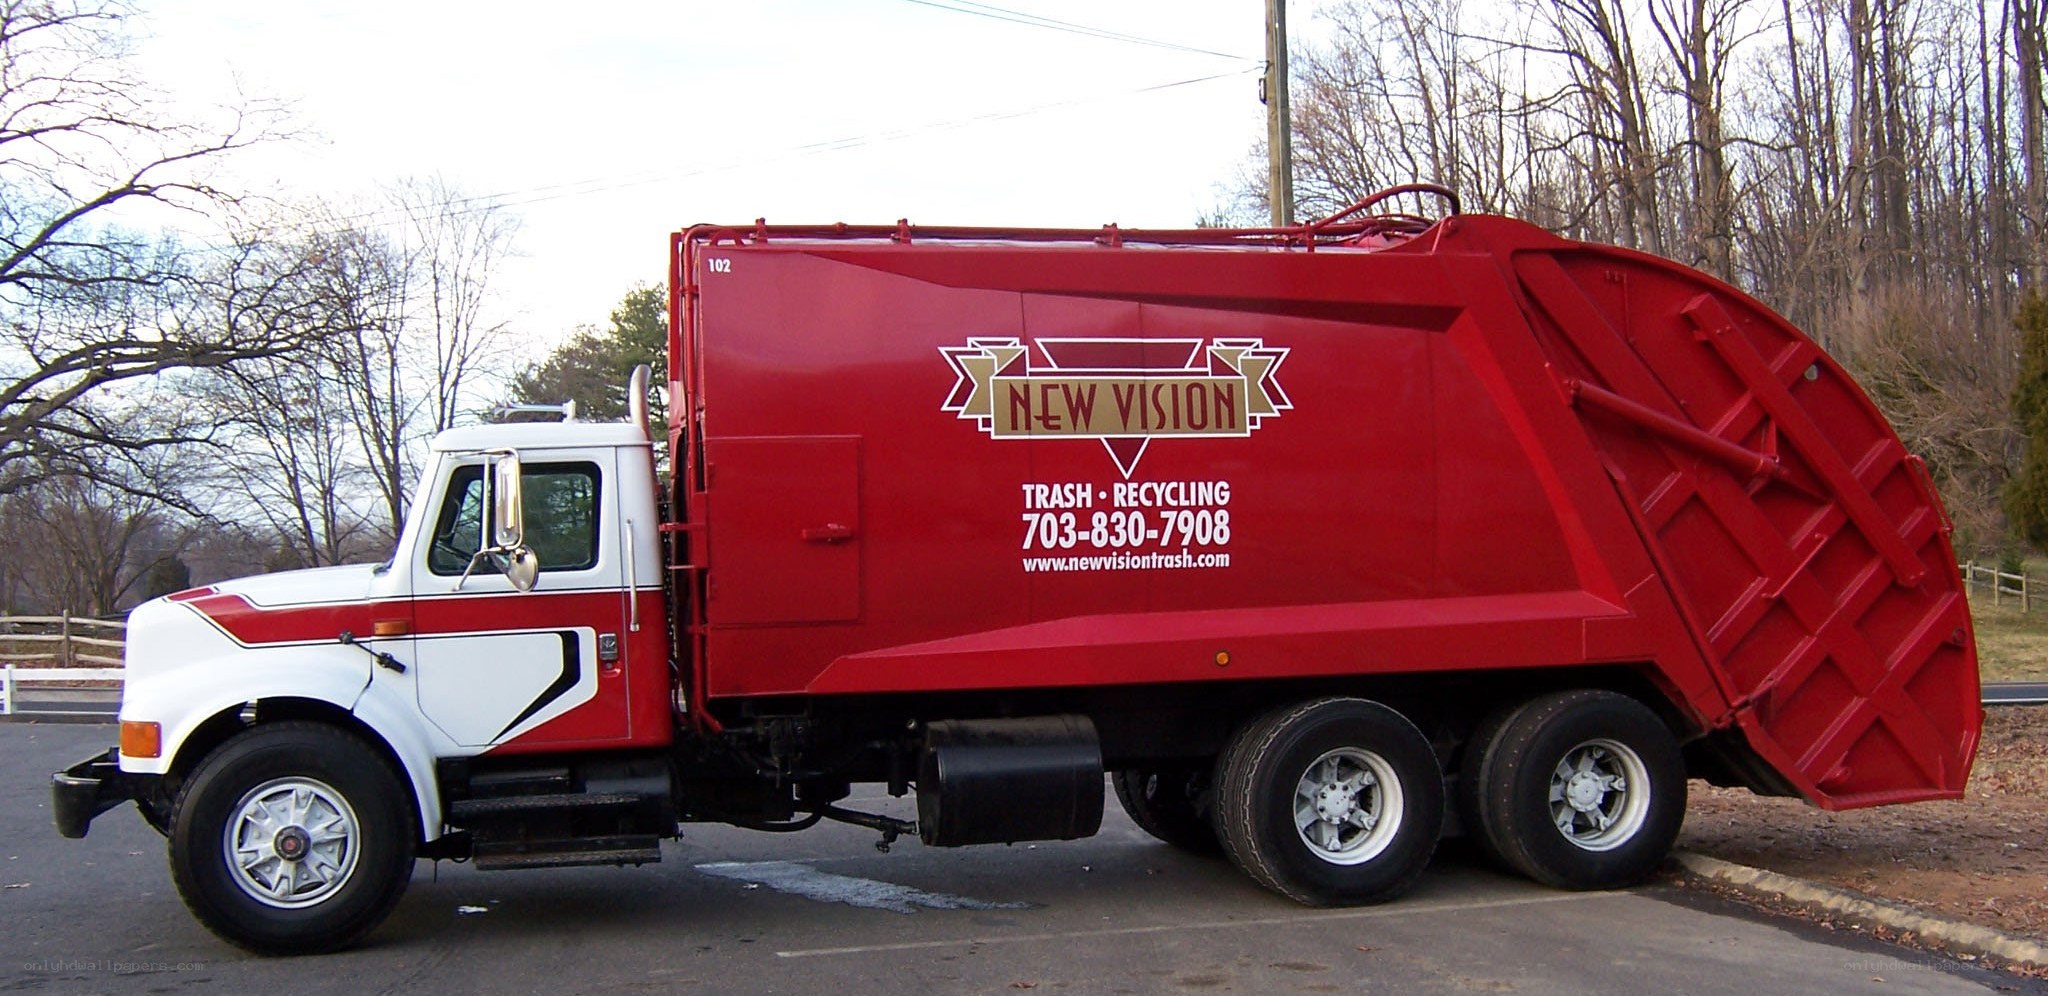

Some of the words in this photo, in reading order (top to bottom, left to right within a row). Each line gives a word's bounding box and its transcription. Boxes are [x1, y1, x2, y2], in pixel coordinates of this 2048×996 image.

[708, 258, 731, 273] 102
[1008, 382, 1097, 431] NEW
[1112, 382, 1236, 431] VISION
[1022, 483, 1092, 508] TRASH
[1113, 481, 1231, 507] RECYCLING
[1022, 509, 1231, 549] 703-830-7908
[1023, 549, 1231, 572] www.newvisiontrash.com
